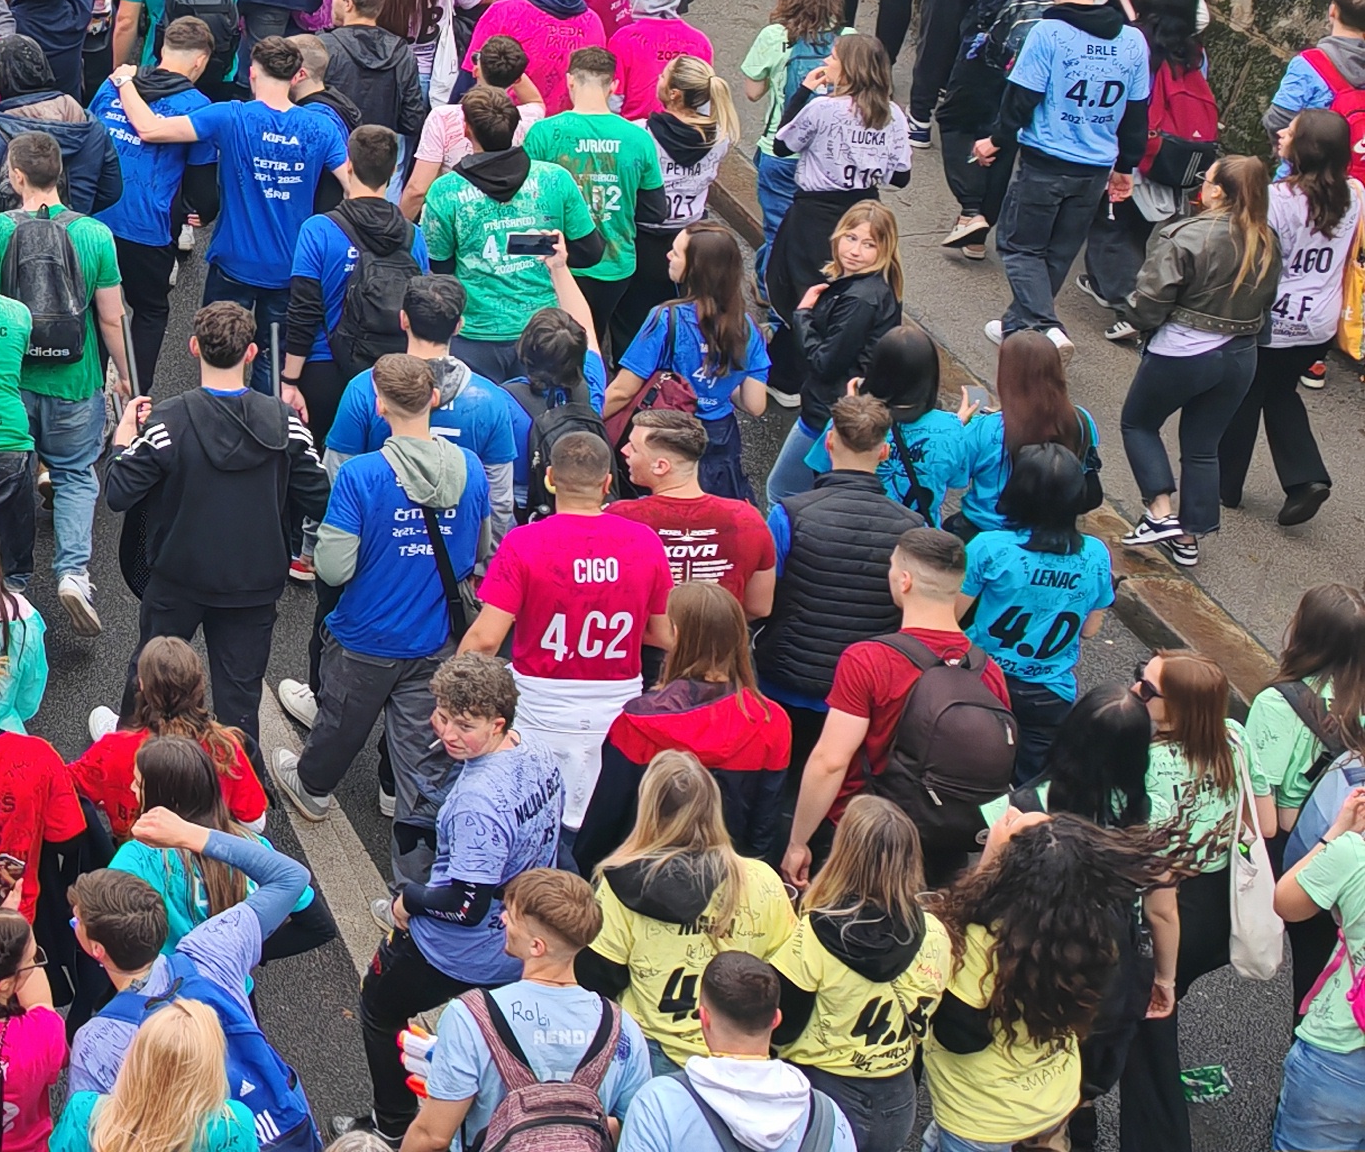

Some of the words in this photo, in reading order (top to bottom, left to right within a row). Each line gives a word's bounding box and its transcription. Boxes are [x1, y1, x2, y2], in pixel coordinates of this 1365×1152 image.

[1087, 43, 1118, 57] BRLE
[1065, 78, 1126, 109] 4.D
[109, 126, 141, 146] TŠRB
[262, 131, 299, 147] KIFLA
[575, 138, 621, 154] JURKOT
[851, 131, 885, 146] LUCKA
[295, 161, 305, 171] D
[264, 187, 290, 201] TŠRB
[1291, 248, 1333, 275] 460
[1273, 294, 1312, 322] 4.F
[573, 557, 618, 585] CIGO
[1031, 566, 1079, 591] LENAC
[540, 612, 633, 664] 4.C2
[988, 603, 1081, 661] 4.D
[510, 1001, 551, 1028] Robi
